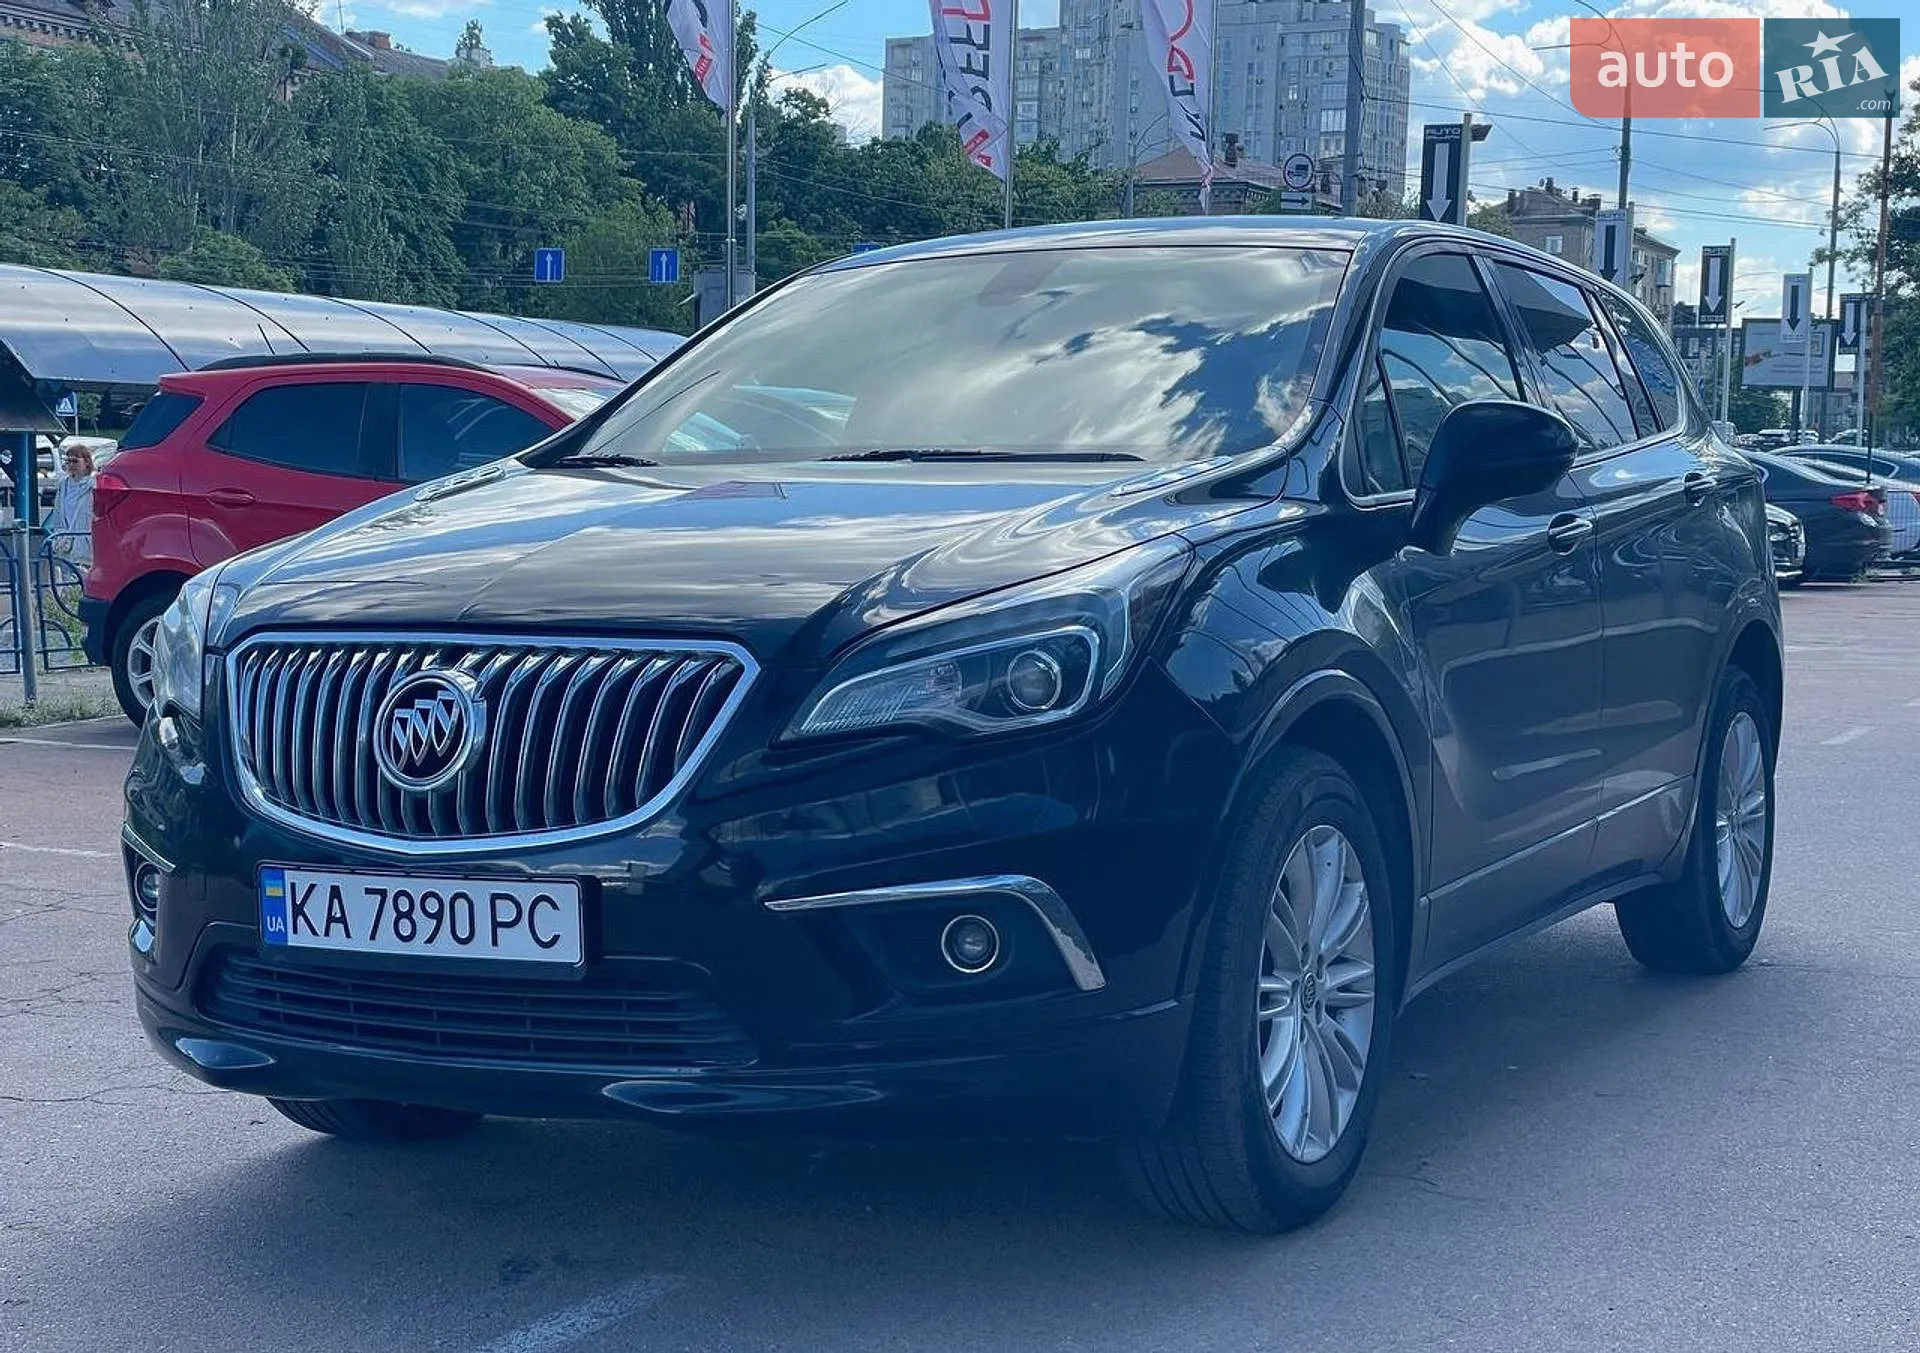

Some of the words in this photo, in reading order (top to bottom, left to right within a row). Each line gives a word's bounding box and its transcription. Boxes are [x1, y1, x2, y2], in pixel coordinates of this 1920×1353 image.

[266, 914, 285, 933] UA
[290, 881, 352, 939] KA
[364, 886, 476, 946] 7890
[489, 892, 562, 949] PC
